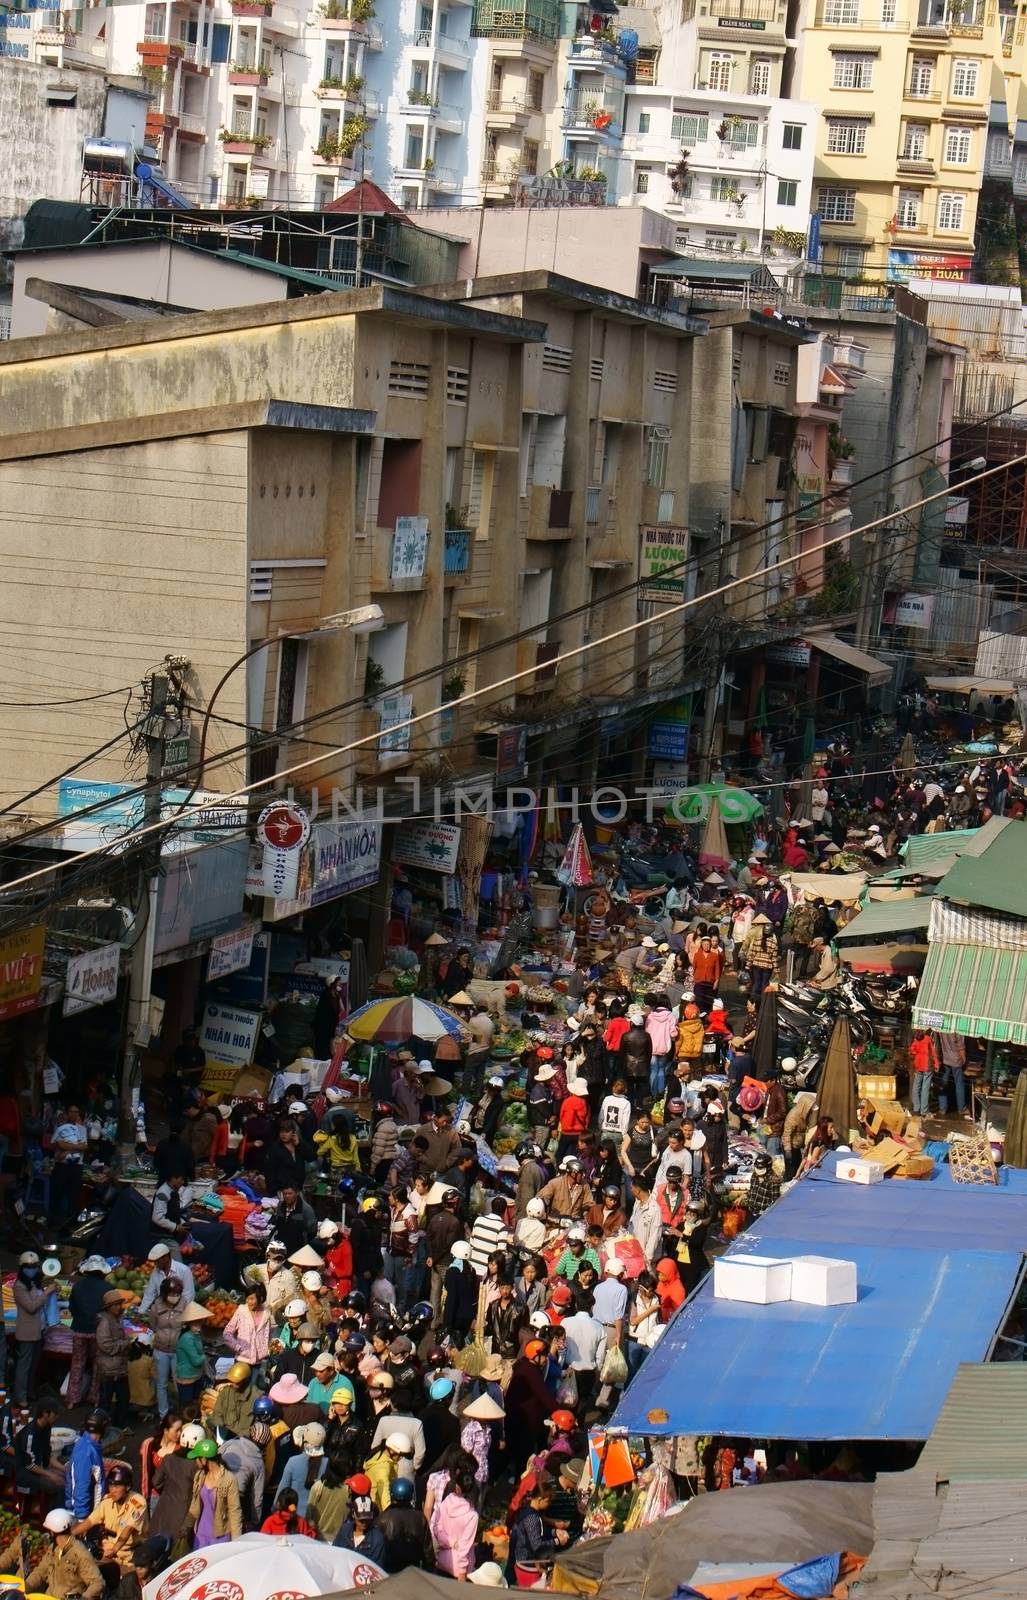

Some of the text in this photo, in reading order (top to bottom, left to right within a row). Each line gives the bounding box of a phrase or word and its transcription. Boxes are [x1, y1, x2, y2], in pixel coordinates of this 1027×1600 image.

[912, 254, 947, 263] HOTEL
[221, 1010, 254, 1026] NHÀ THUỐC
[205, 1027, 251, 1049] NHÂN HOÀ
